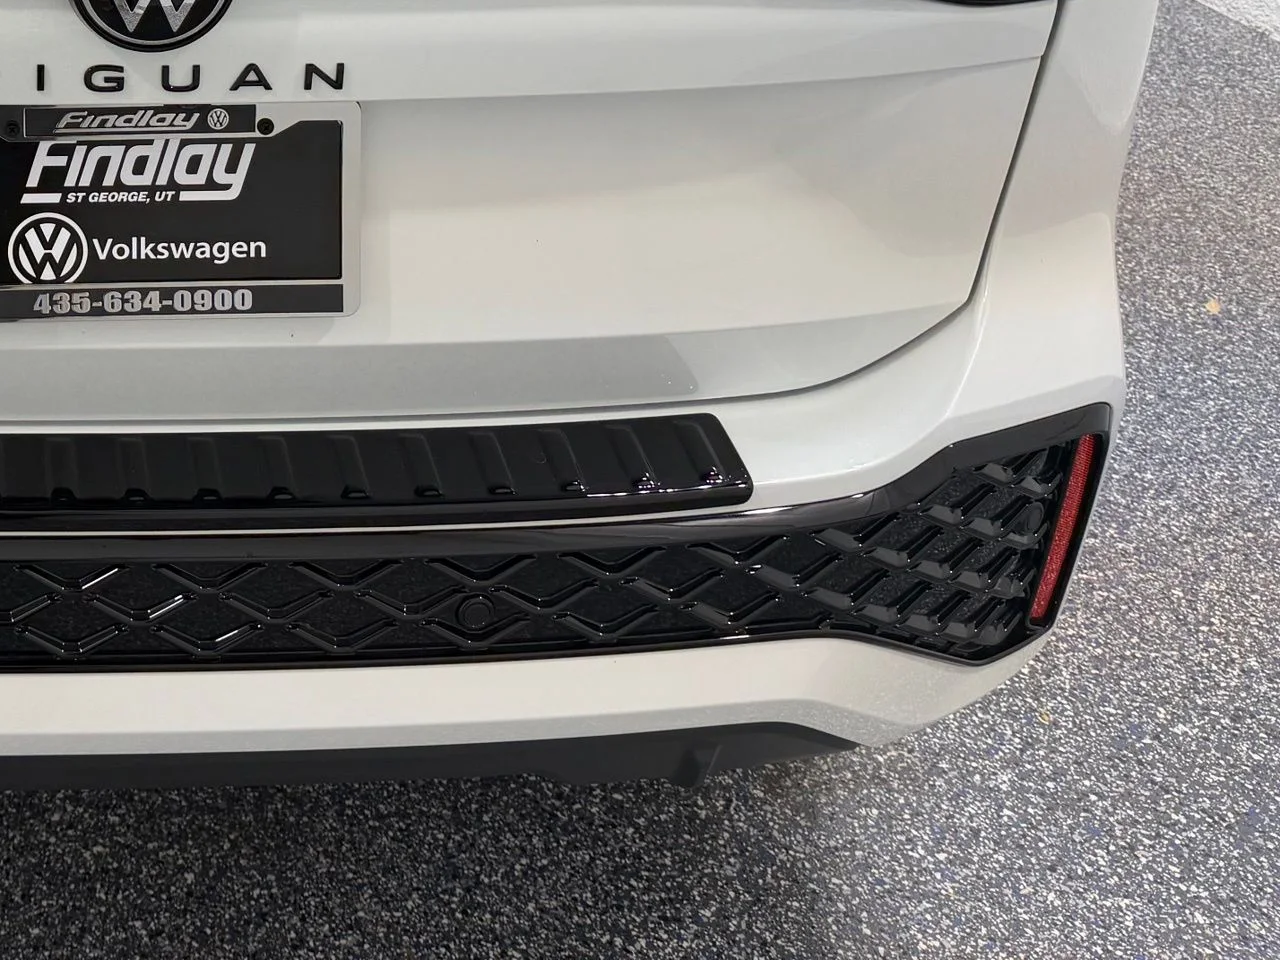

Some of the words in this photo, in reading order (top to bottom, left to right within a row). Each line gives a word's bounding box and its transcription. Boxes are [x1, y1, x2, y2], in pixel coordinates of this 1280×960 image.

[54, 109, 201, 133] Findlay
[21, 138, 257, 203] Findlay
[66, 192, 87, 203] ST
[88, 191, 151, 204] GEORGE,
[154, 190, 176, 202] UT
[92, 236, 267, 265] Volkswagen
[33, 288, 253, 315] 435-634-0900
